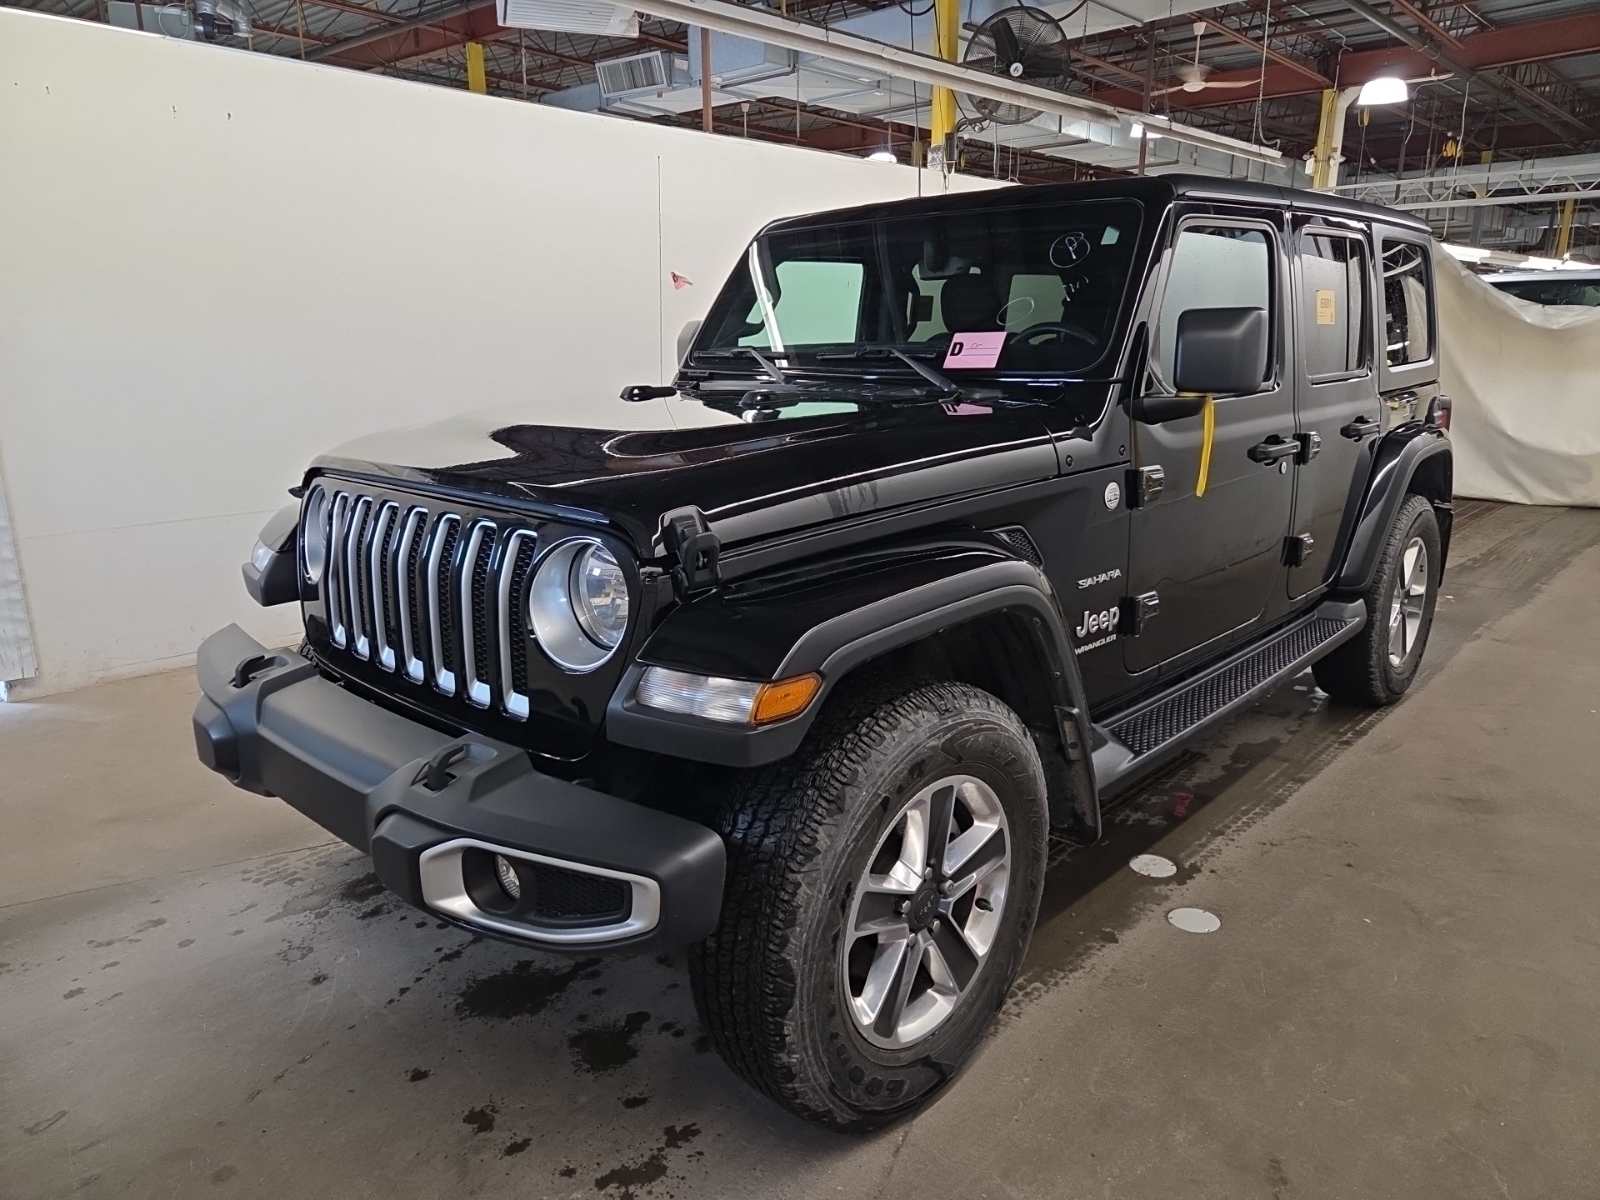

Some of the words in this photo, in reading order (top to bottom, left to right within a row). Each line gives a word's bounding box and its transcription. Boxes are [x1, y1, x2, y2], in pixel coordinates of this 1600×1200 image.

[949, 341, 964, 357] D
[1076, 568, 1122, 589] SAHARA
[1076, 606, 1120, 638] Jeep
[1074, 634, 1117, 655] WRANGLER
